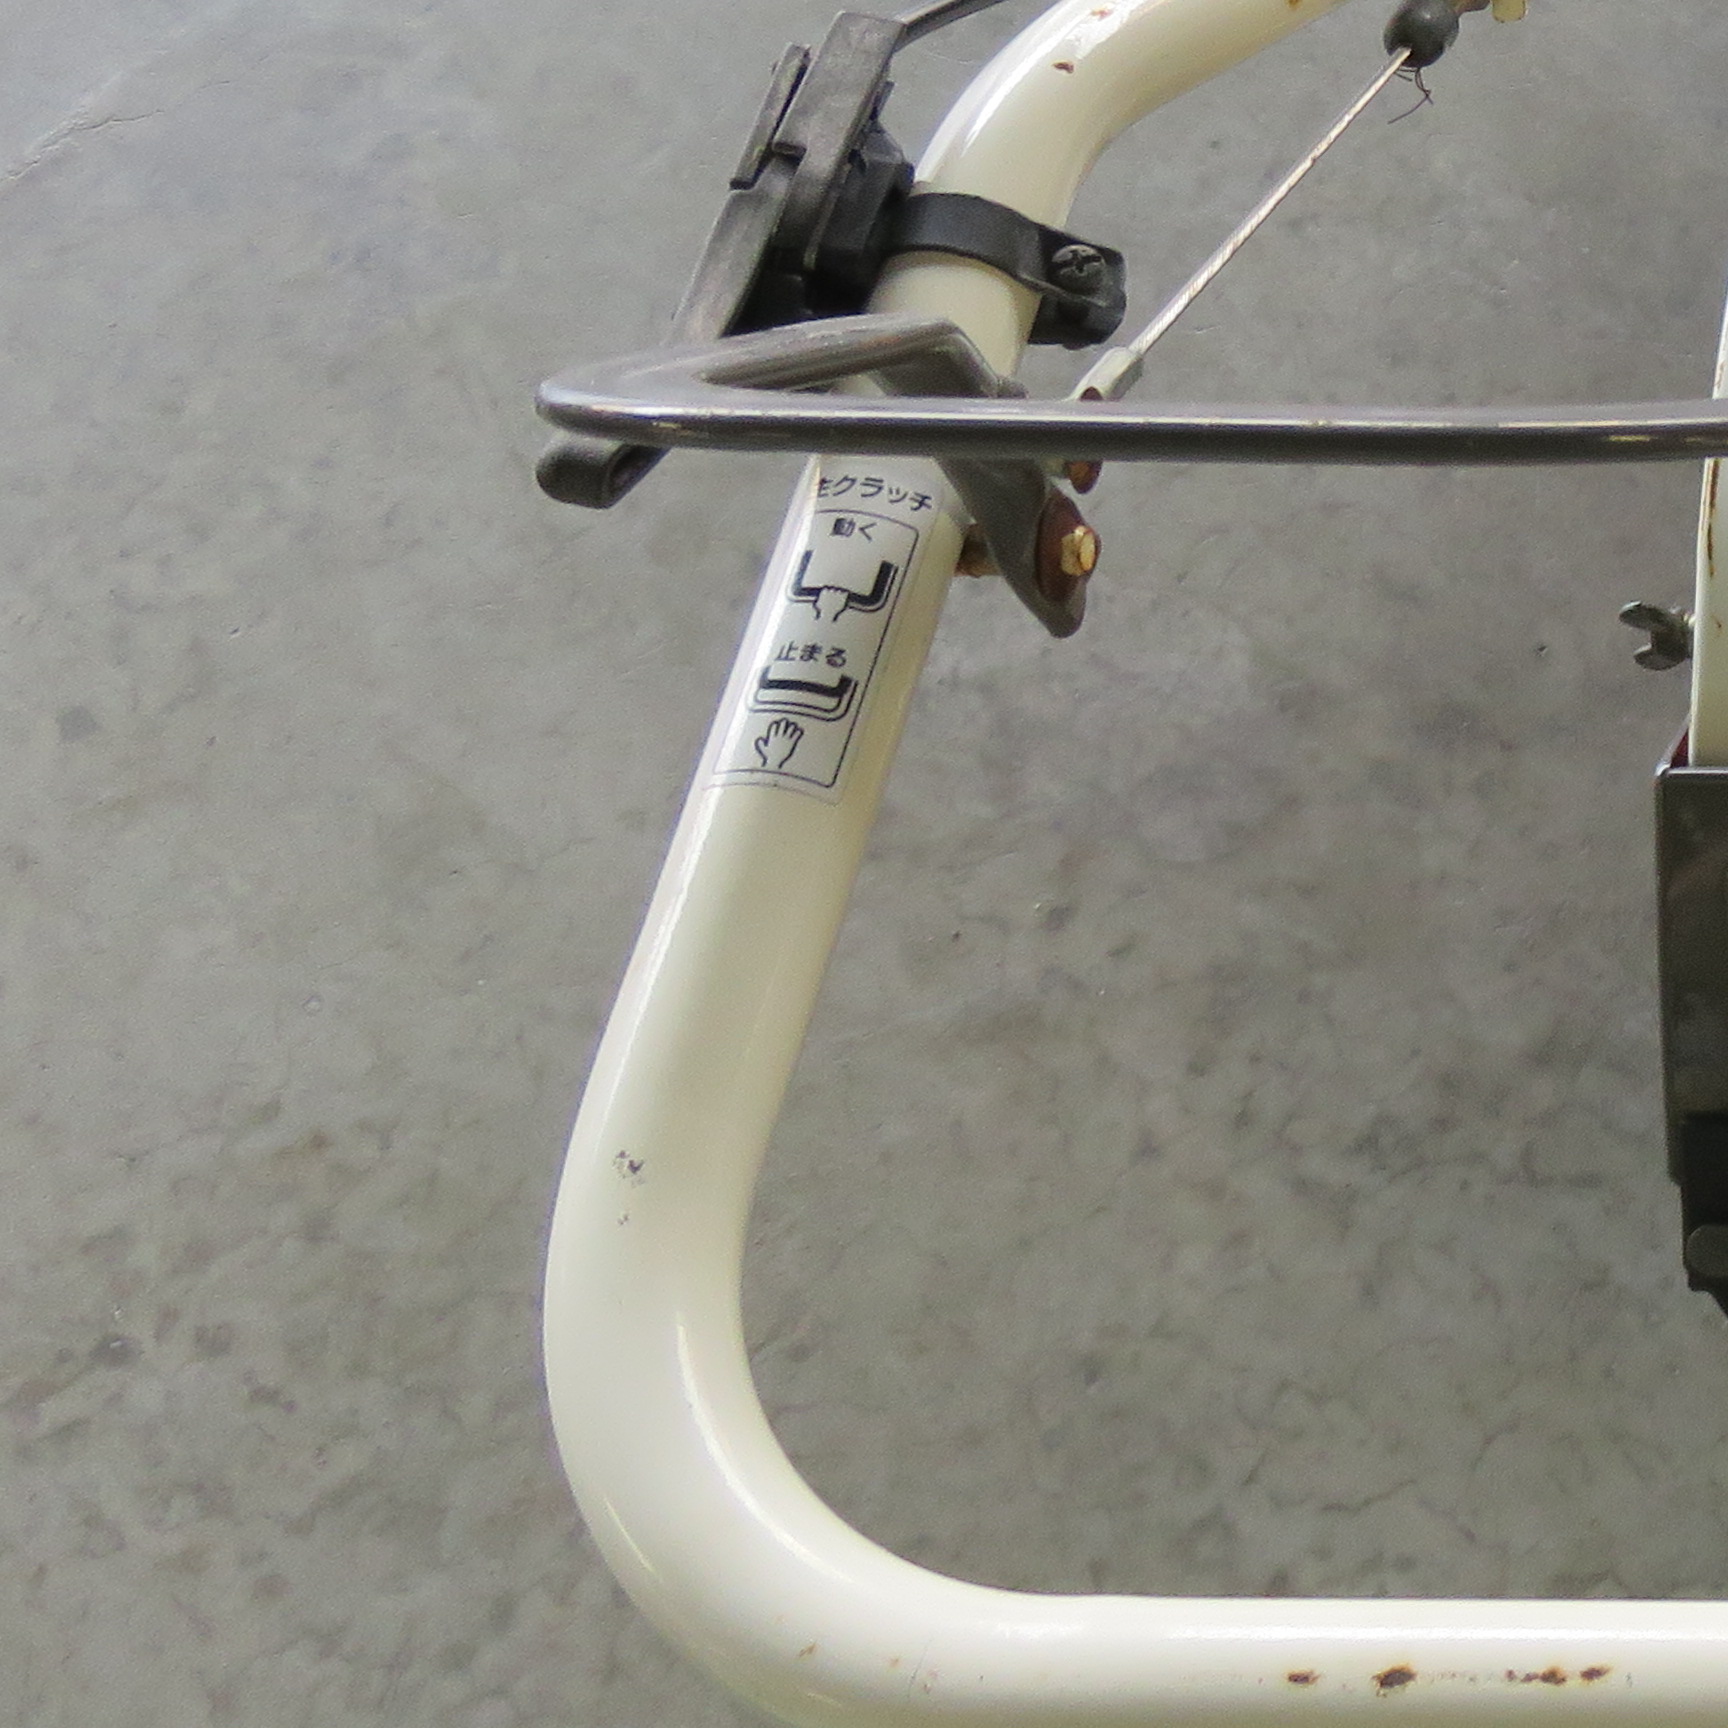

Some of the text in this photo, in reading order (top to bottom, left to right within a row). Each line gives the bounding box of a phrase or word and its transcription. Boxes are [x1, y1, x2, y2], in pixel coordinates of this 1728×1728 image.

[830, 517, 878, 542] 動く
[776, 640, 848, 668] 止まる
